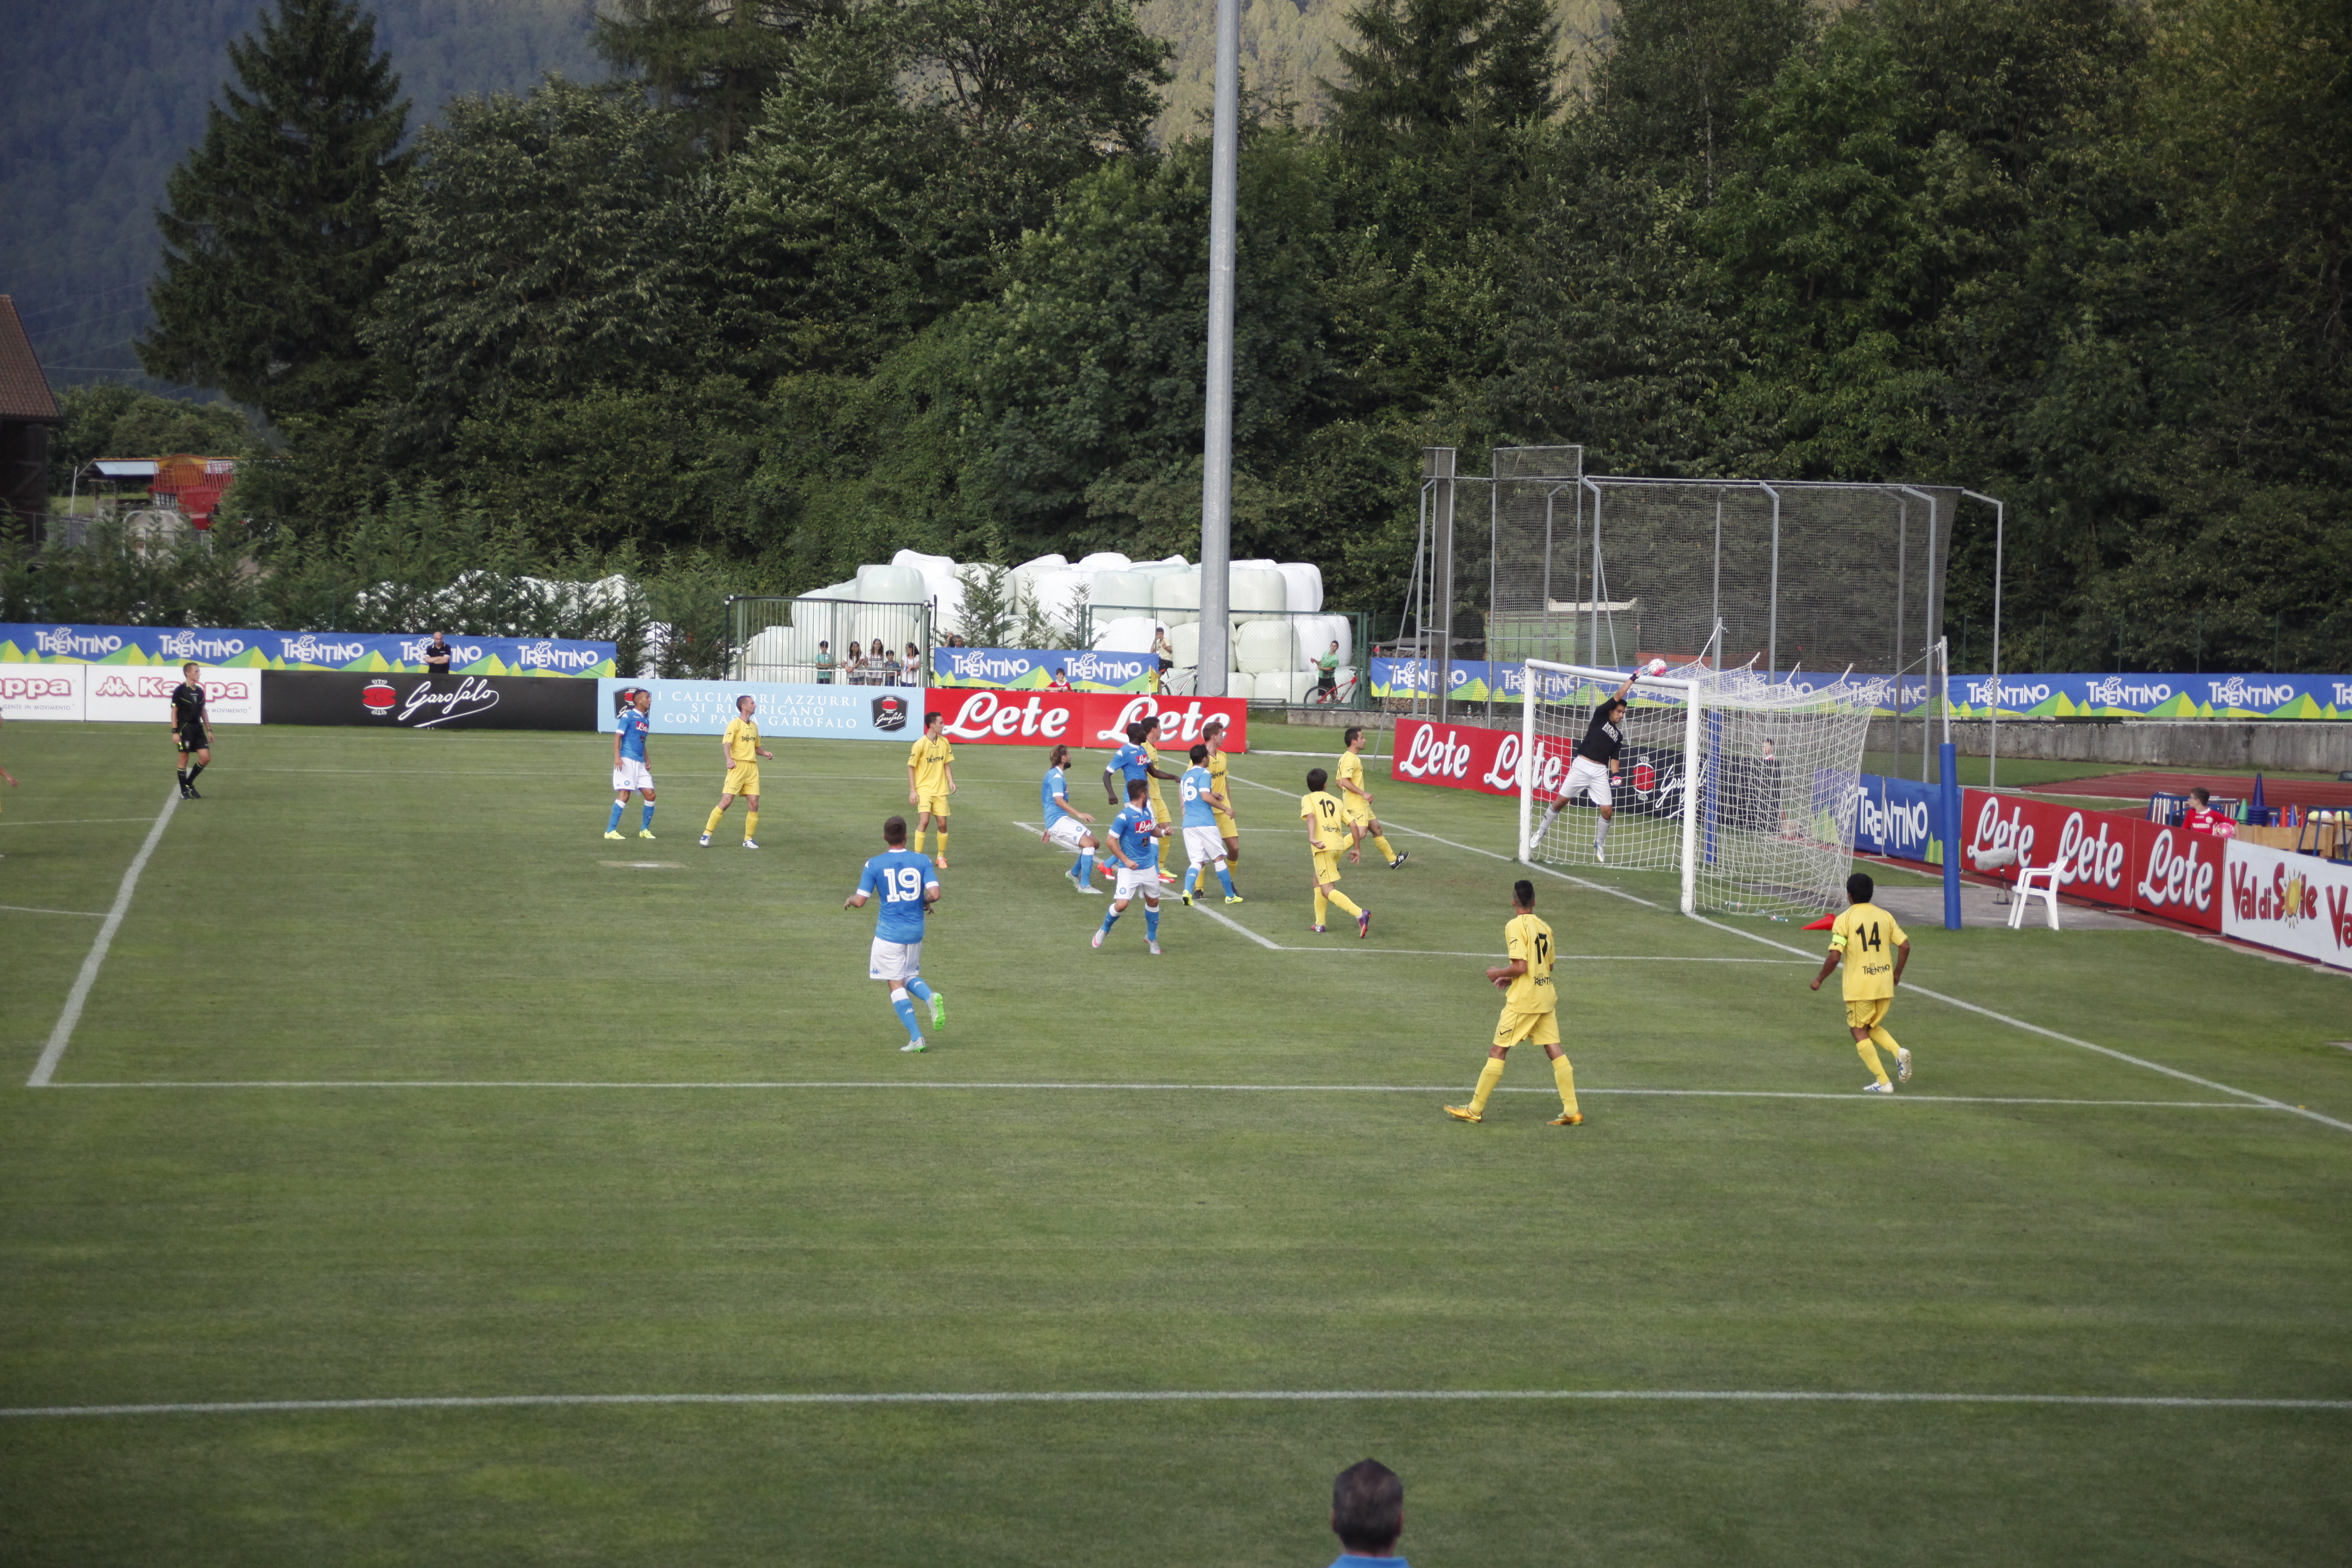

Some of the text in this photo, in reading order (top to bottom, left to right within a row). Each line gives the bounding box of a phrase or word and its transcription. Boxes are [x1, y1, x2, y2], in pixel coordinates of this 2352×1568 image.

[36, 632, 122, 655] TRENTINO
[159, 635, 244, 658] TRENTINO
[281, 638, 364, 661] TRENTINO
[400, 642, 482, 664] TREINO
[518, 645, 598, 668] TRENTINO
[951, 655, 1029, 677] TRENTINO
[1064, 658, 1142, 680] TRENTINO
[0, 677, 71, 699] ppa
[139, 676, 248, 702] Kapa
[398, 676, 493, 721] Garofalo
[658, 691, 662, 700] I
[784, 695, 857, 707] AZZURRI
[1967, 683, 2050, 706] TRENTINO
[2086, 682, 2171, 706] TRENTINO
[2208, 682, 2294, 707] TRENTINO
[664, 713, 857, 728] CON PASA GAROFALO
[691, 703, 824, 716] SI RIRICANO
[874, 712, 905, 726] Garofalo
[941, 692, 1069, 739] Lete
[1400, 724, 1470, 779] Lete
[1856, 786, 1928, 850] TRENTINO
[1967, 797, 2035, 868] Lete
[2048, 812, 2124, 890] Lete
[2138, 829, 2213, 912] Lete
[884, 867, 921, 903] 19
[2229, 861, 2257, 924] Val
[2258, 887, 2272, 920] di
[1856, 921, 1881, 952] 14
[1862, 964, 1890, 975] TRENTINO
